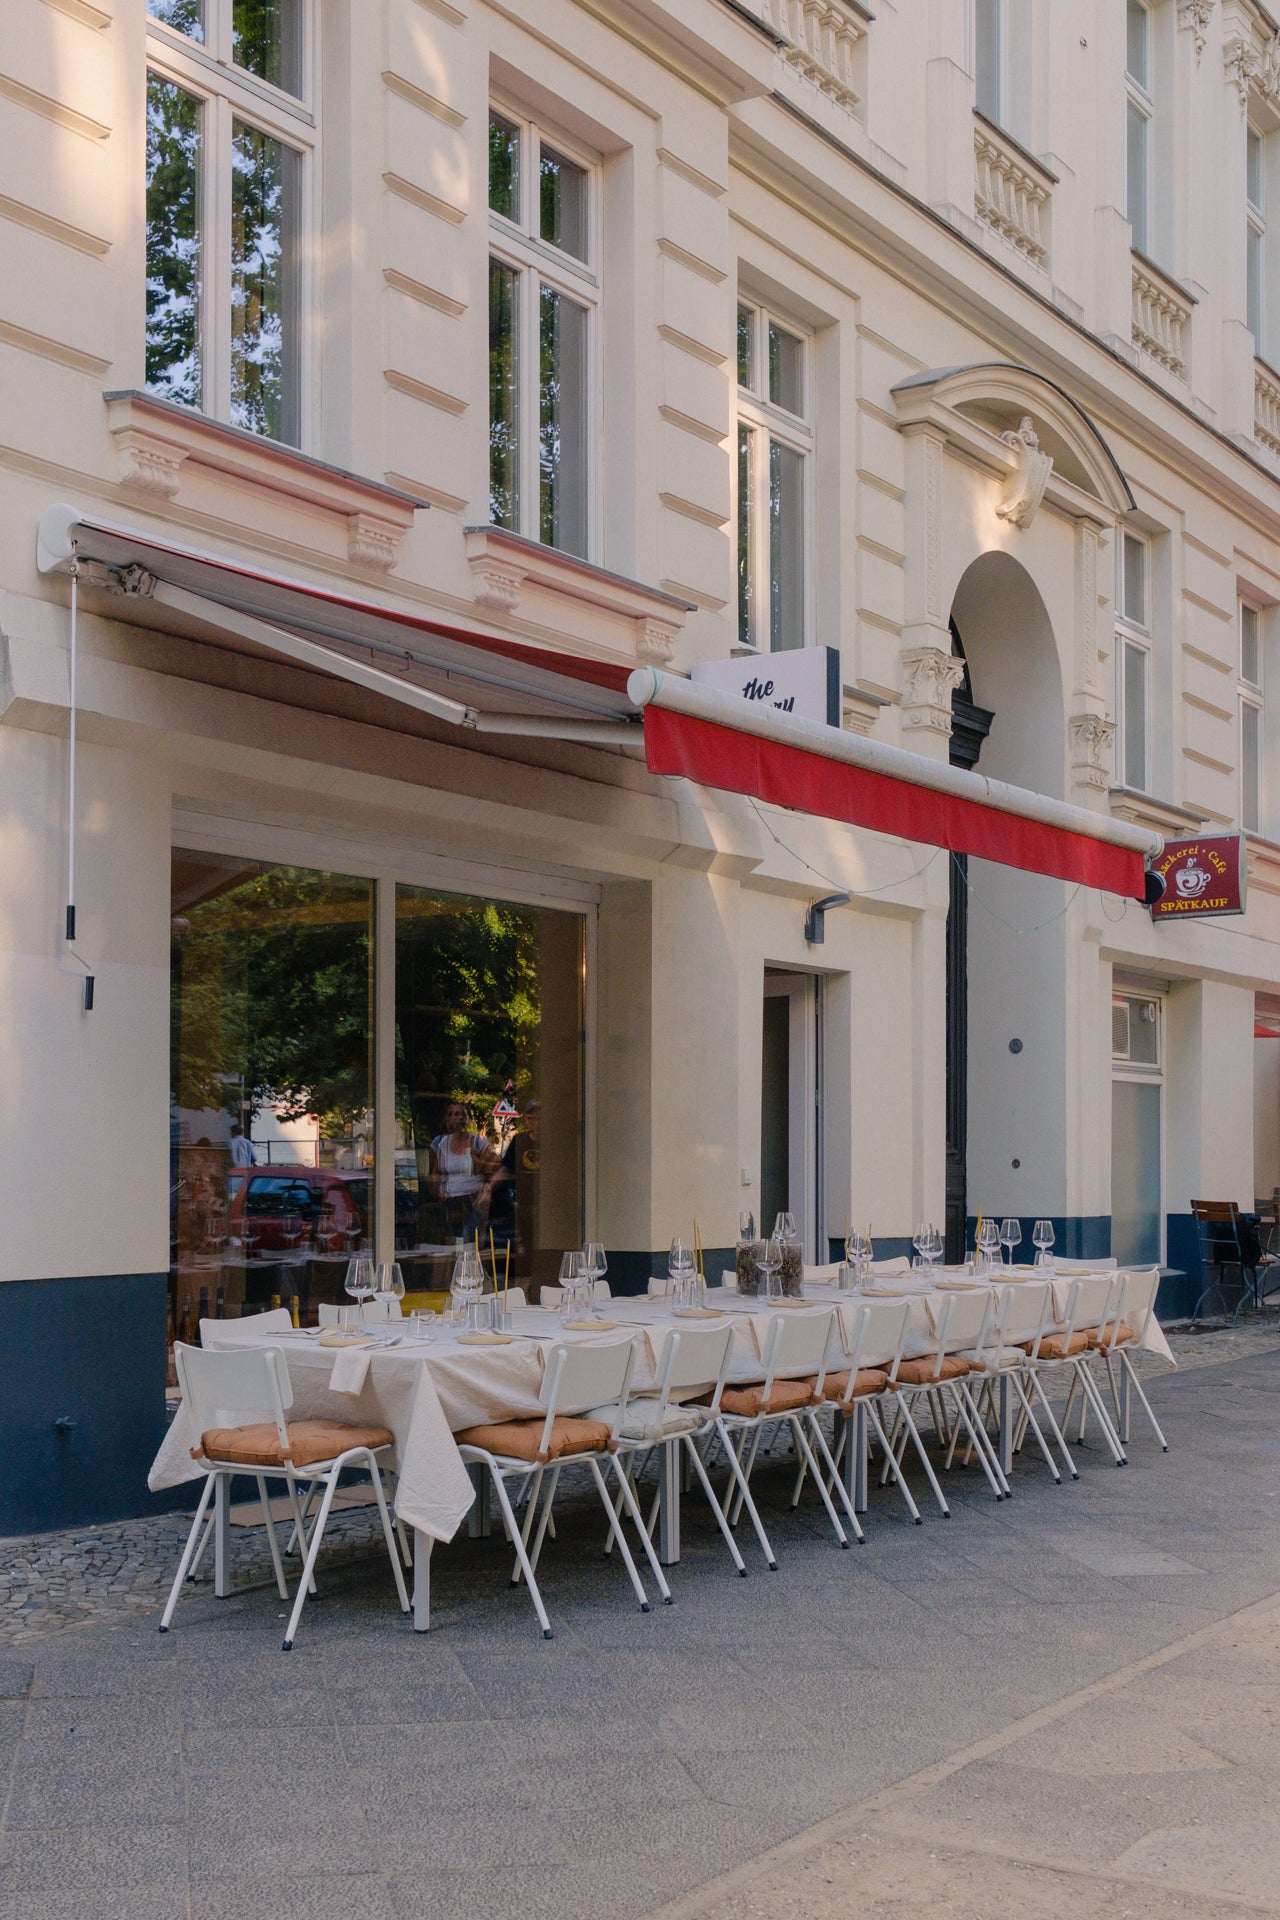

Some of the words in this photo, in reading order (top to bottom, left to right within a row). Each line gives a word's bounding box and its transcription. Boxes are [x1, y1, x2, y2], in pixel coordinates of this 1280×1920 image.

[742, 677, 774, 701] the
[1208, 851, 1227, 874] Café
[1160, 898, 1229, 912] SPÄTKAUF
